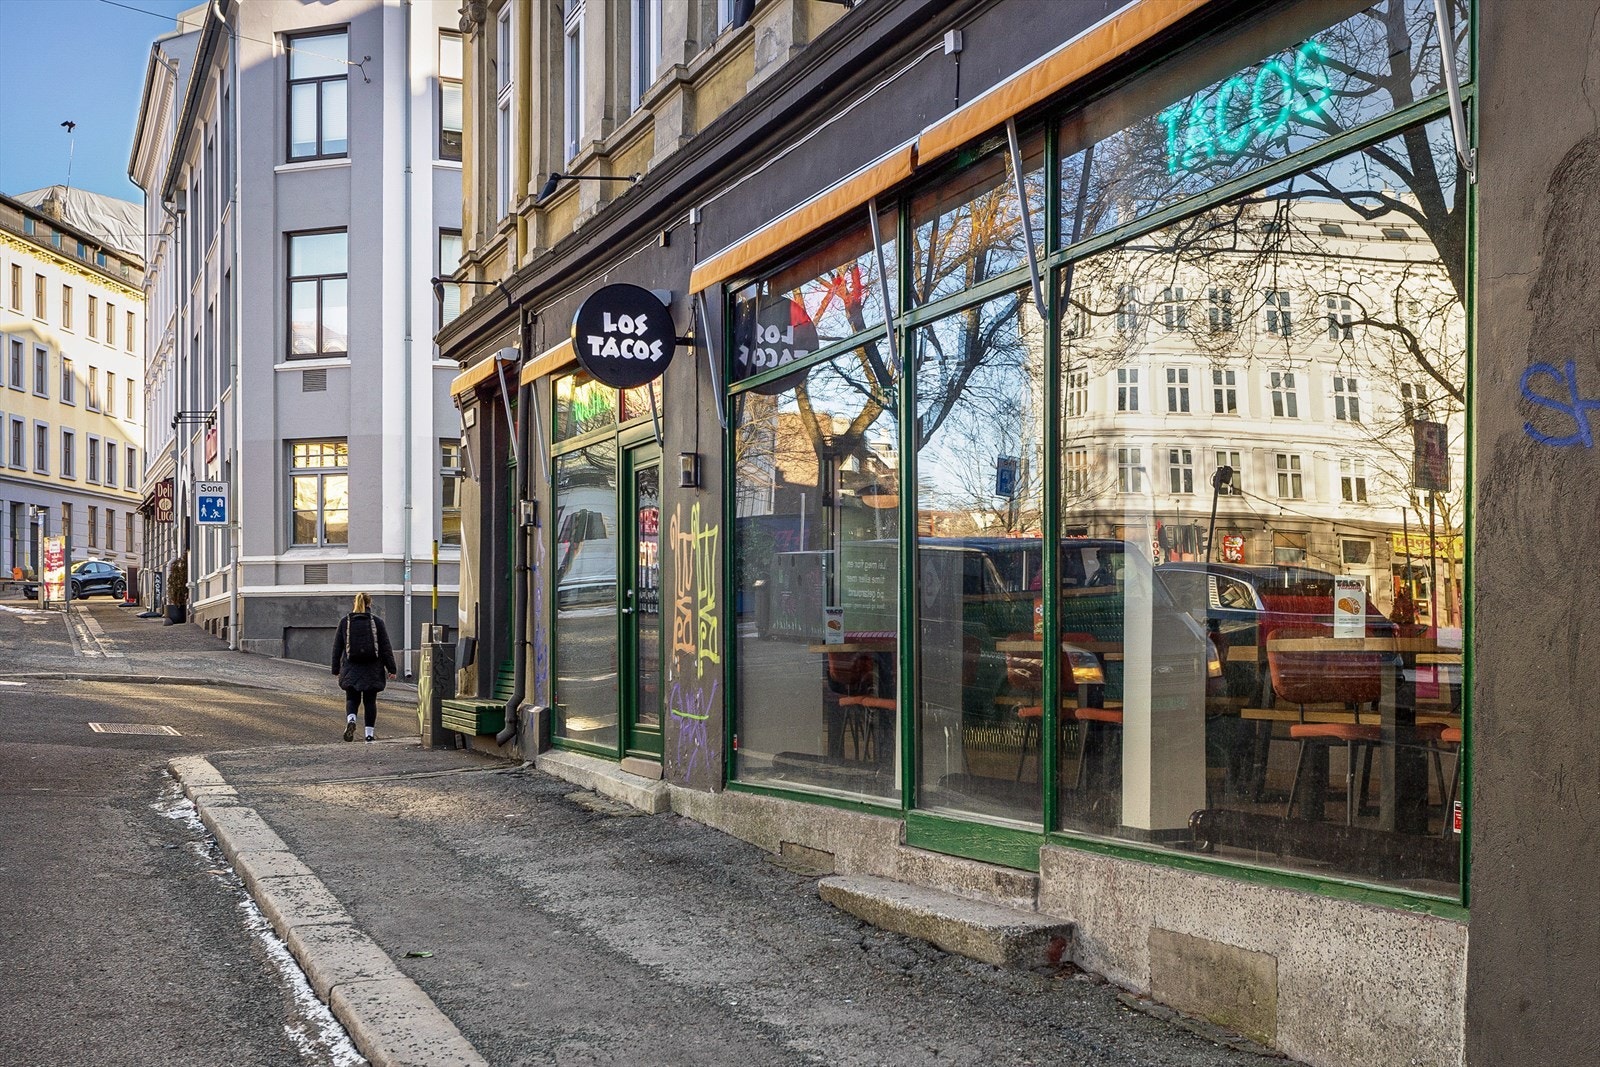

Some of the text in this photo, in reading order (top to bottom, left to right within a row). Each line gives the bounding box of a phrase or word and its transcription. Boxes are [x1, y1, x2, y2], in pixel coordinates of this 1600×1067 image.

[1157, 40, 1332, 176] TACOS
[603, 312, 648, 334] LOS
[587, 335, 663, 362] TACOS
[157, 483, 173, 497] Deli
[200, 484, 224, 493] Sone
[160, 499, 170, 509] de
[157, 507, 174, 521] Luca
